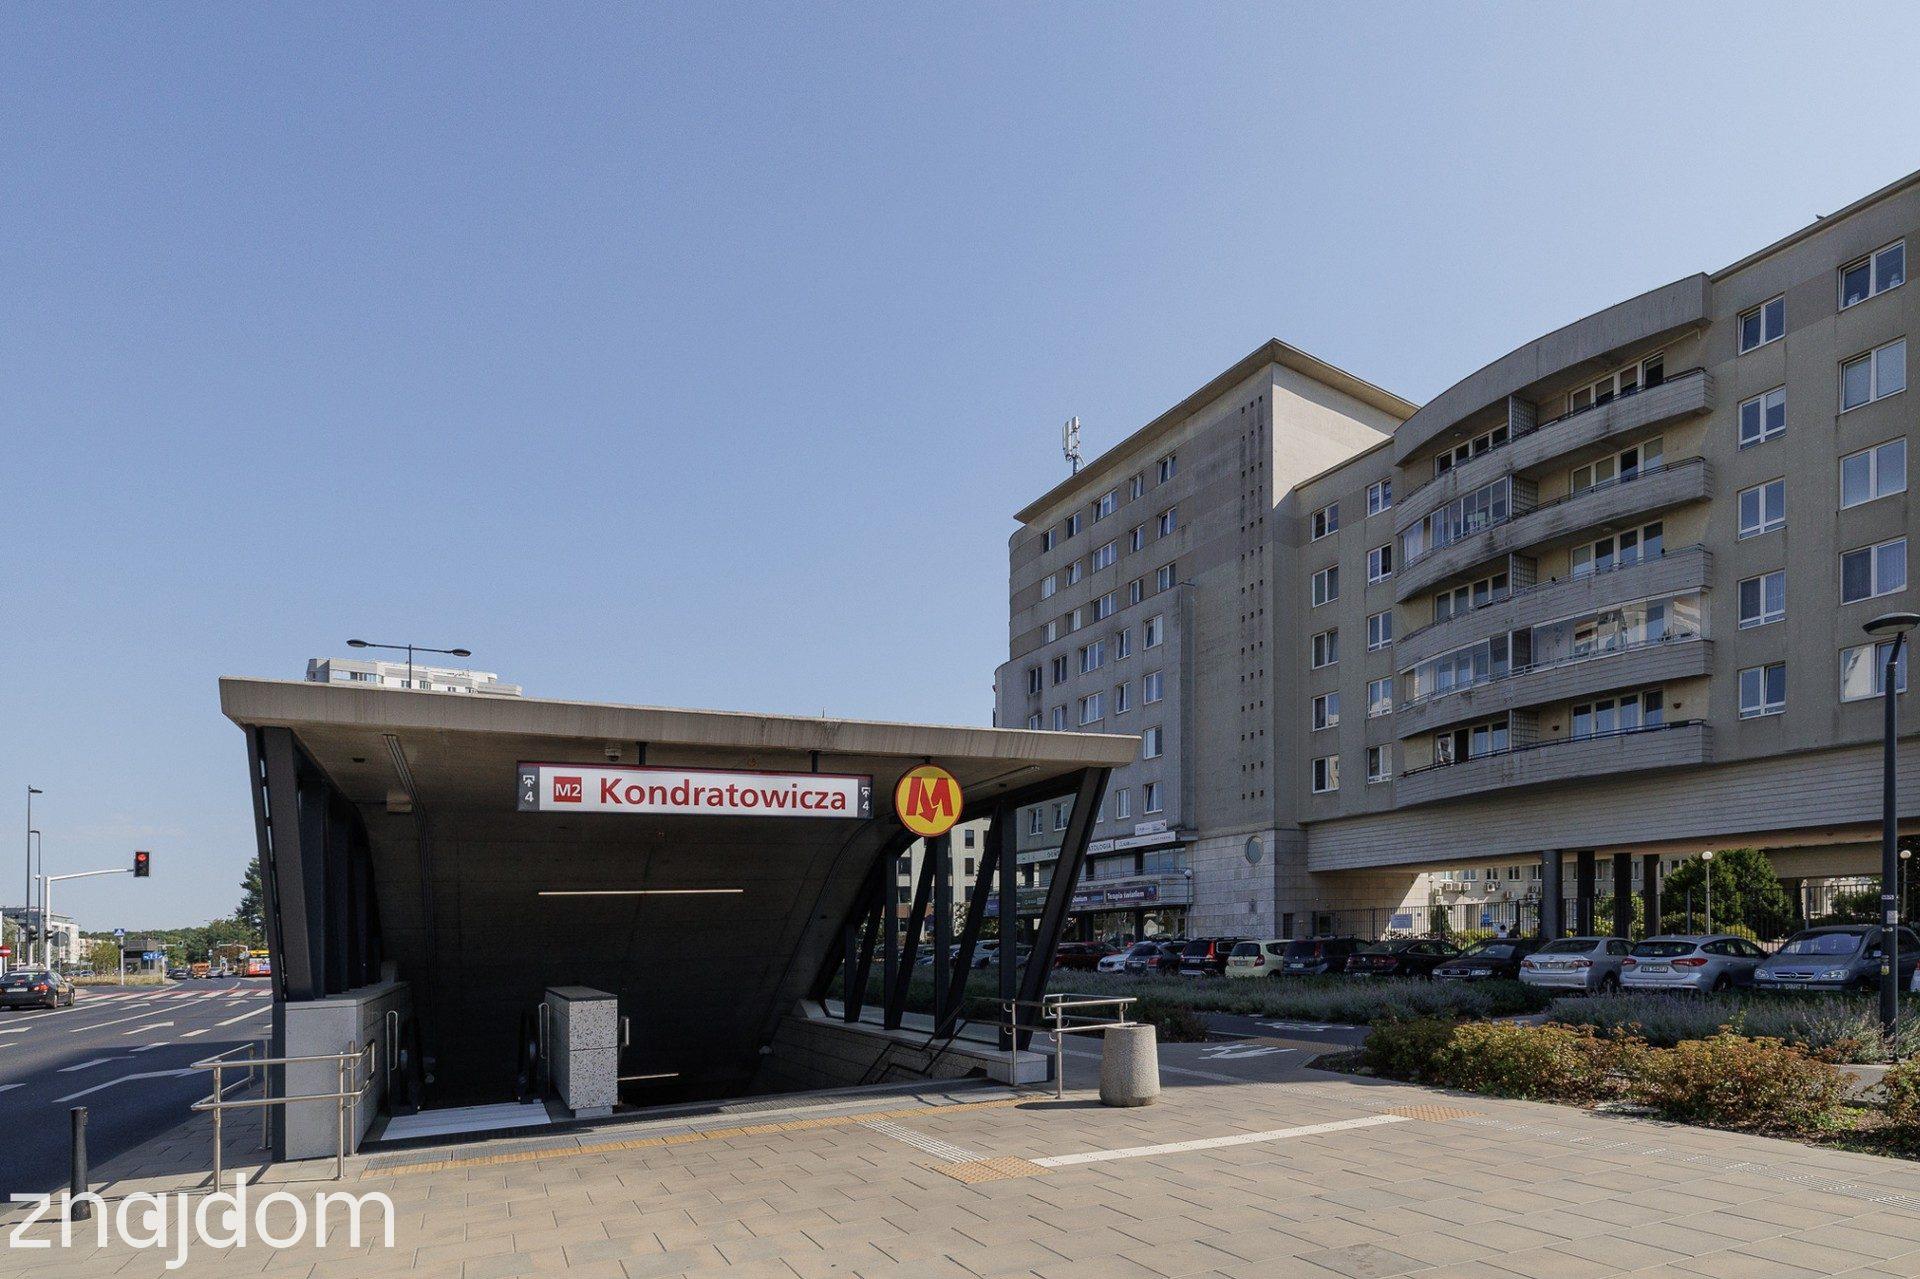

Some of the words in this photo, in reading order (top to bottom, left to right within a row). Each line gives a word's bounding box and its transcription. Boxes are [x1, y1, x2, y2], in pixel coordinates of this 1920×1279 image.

[524, 791, 534, 802] 4
[555, 783, 581, 797] M2
[600, 777, 846, 811] Kondratowicza
[862, 801, 870, 811] 4
